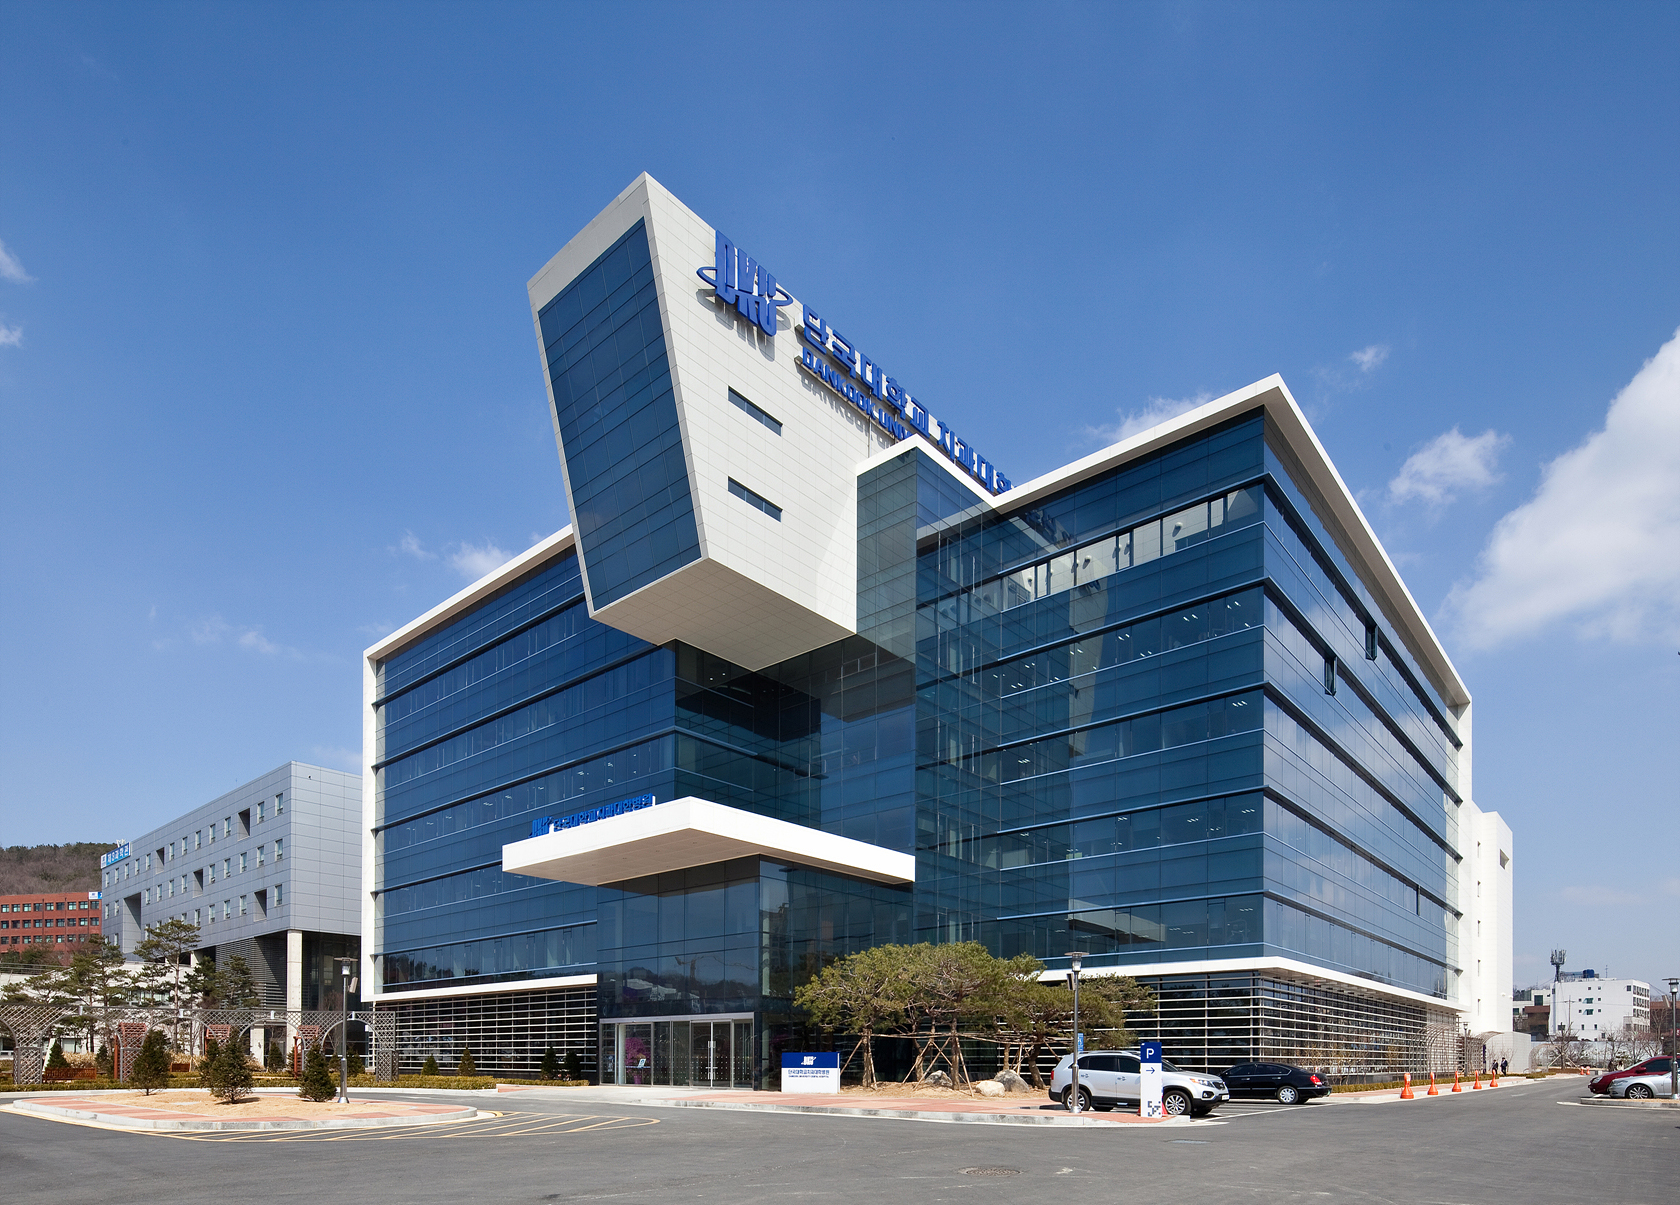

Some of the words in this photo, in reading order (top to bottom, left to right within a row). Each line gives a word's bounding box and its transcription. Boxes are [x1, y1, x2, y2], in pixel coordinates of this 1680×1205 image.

[802, 347, 876, 420] DANKOOK
[803, 304, 931, 438] 단국대학교
[1146, 1048, 1155, 1059] P
